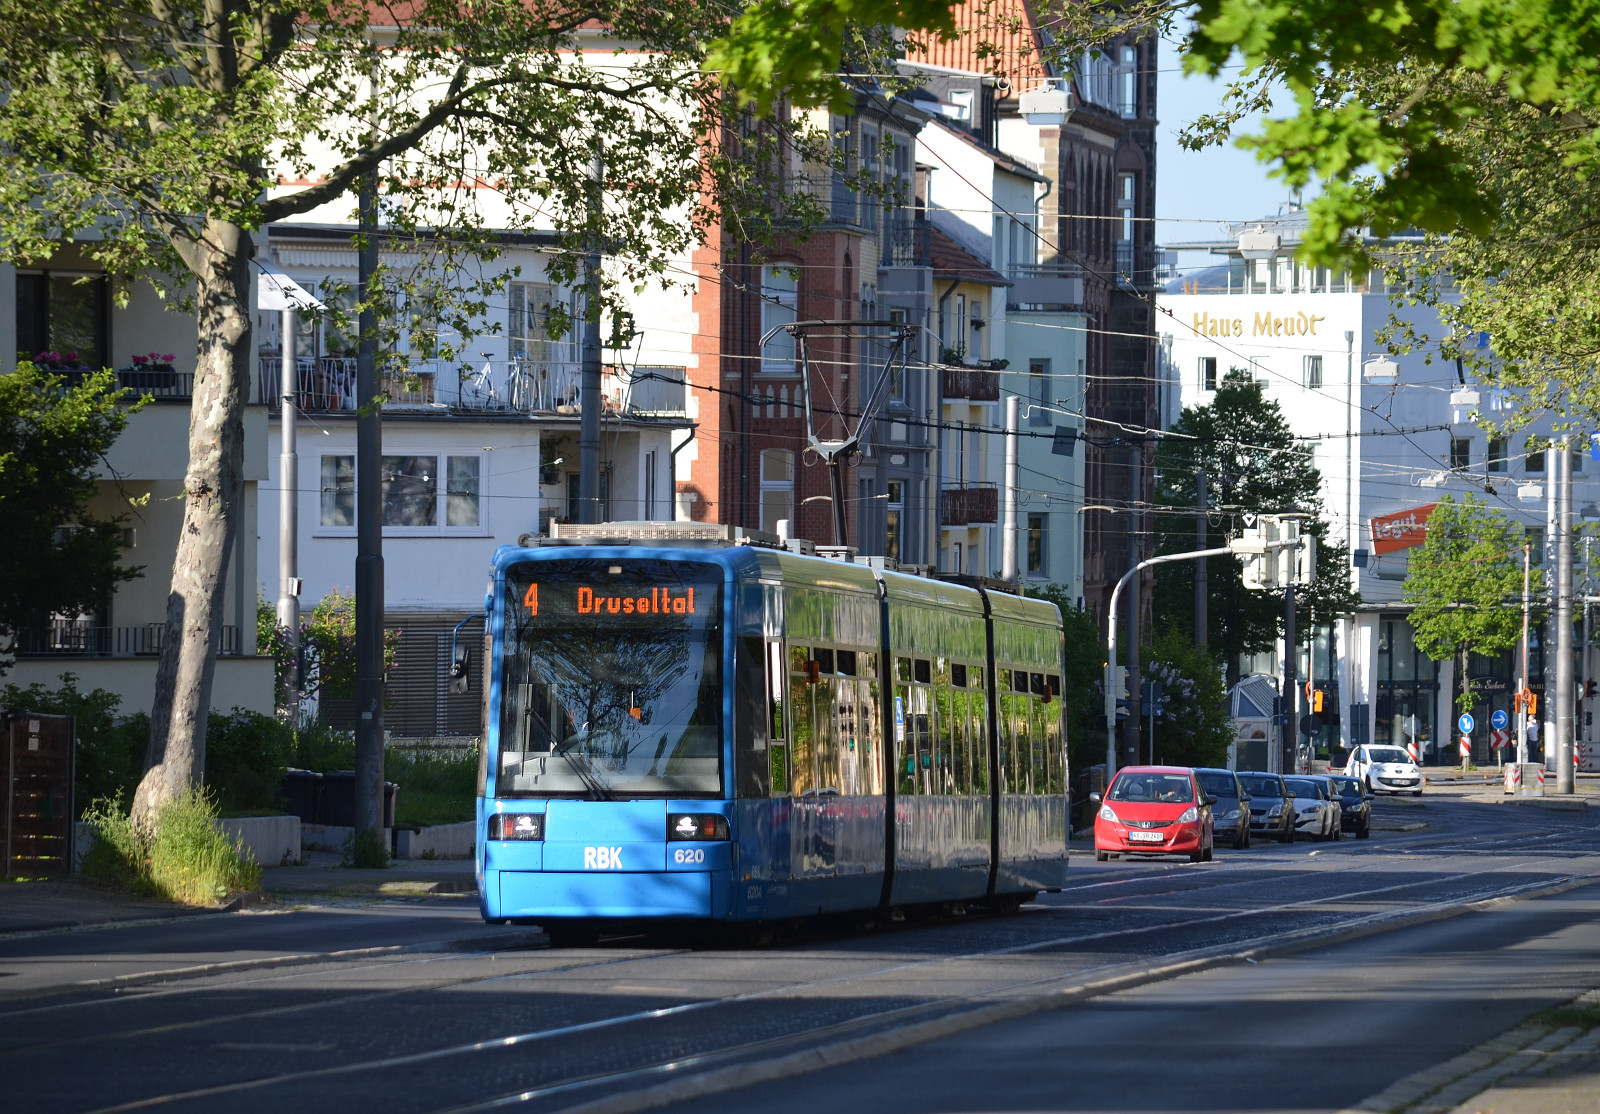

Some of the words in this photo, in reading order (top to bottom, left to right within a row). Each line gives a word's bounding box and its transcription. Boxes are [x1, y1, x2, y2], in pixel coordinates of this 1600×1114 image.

[1193, 311, 1242, 337] Haus
[1253, 311, 1325, 337] Meudt
[524, 582, 539, 617] 4
[577, 586, 695, 614] Druseltal
[584, 846, 623, 870] RBK
[674, 848, 705, 864] 620
